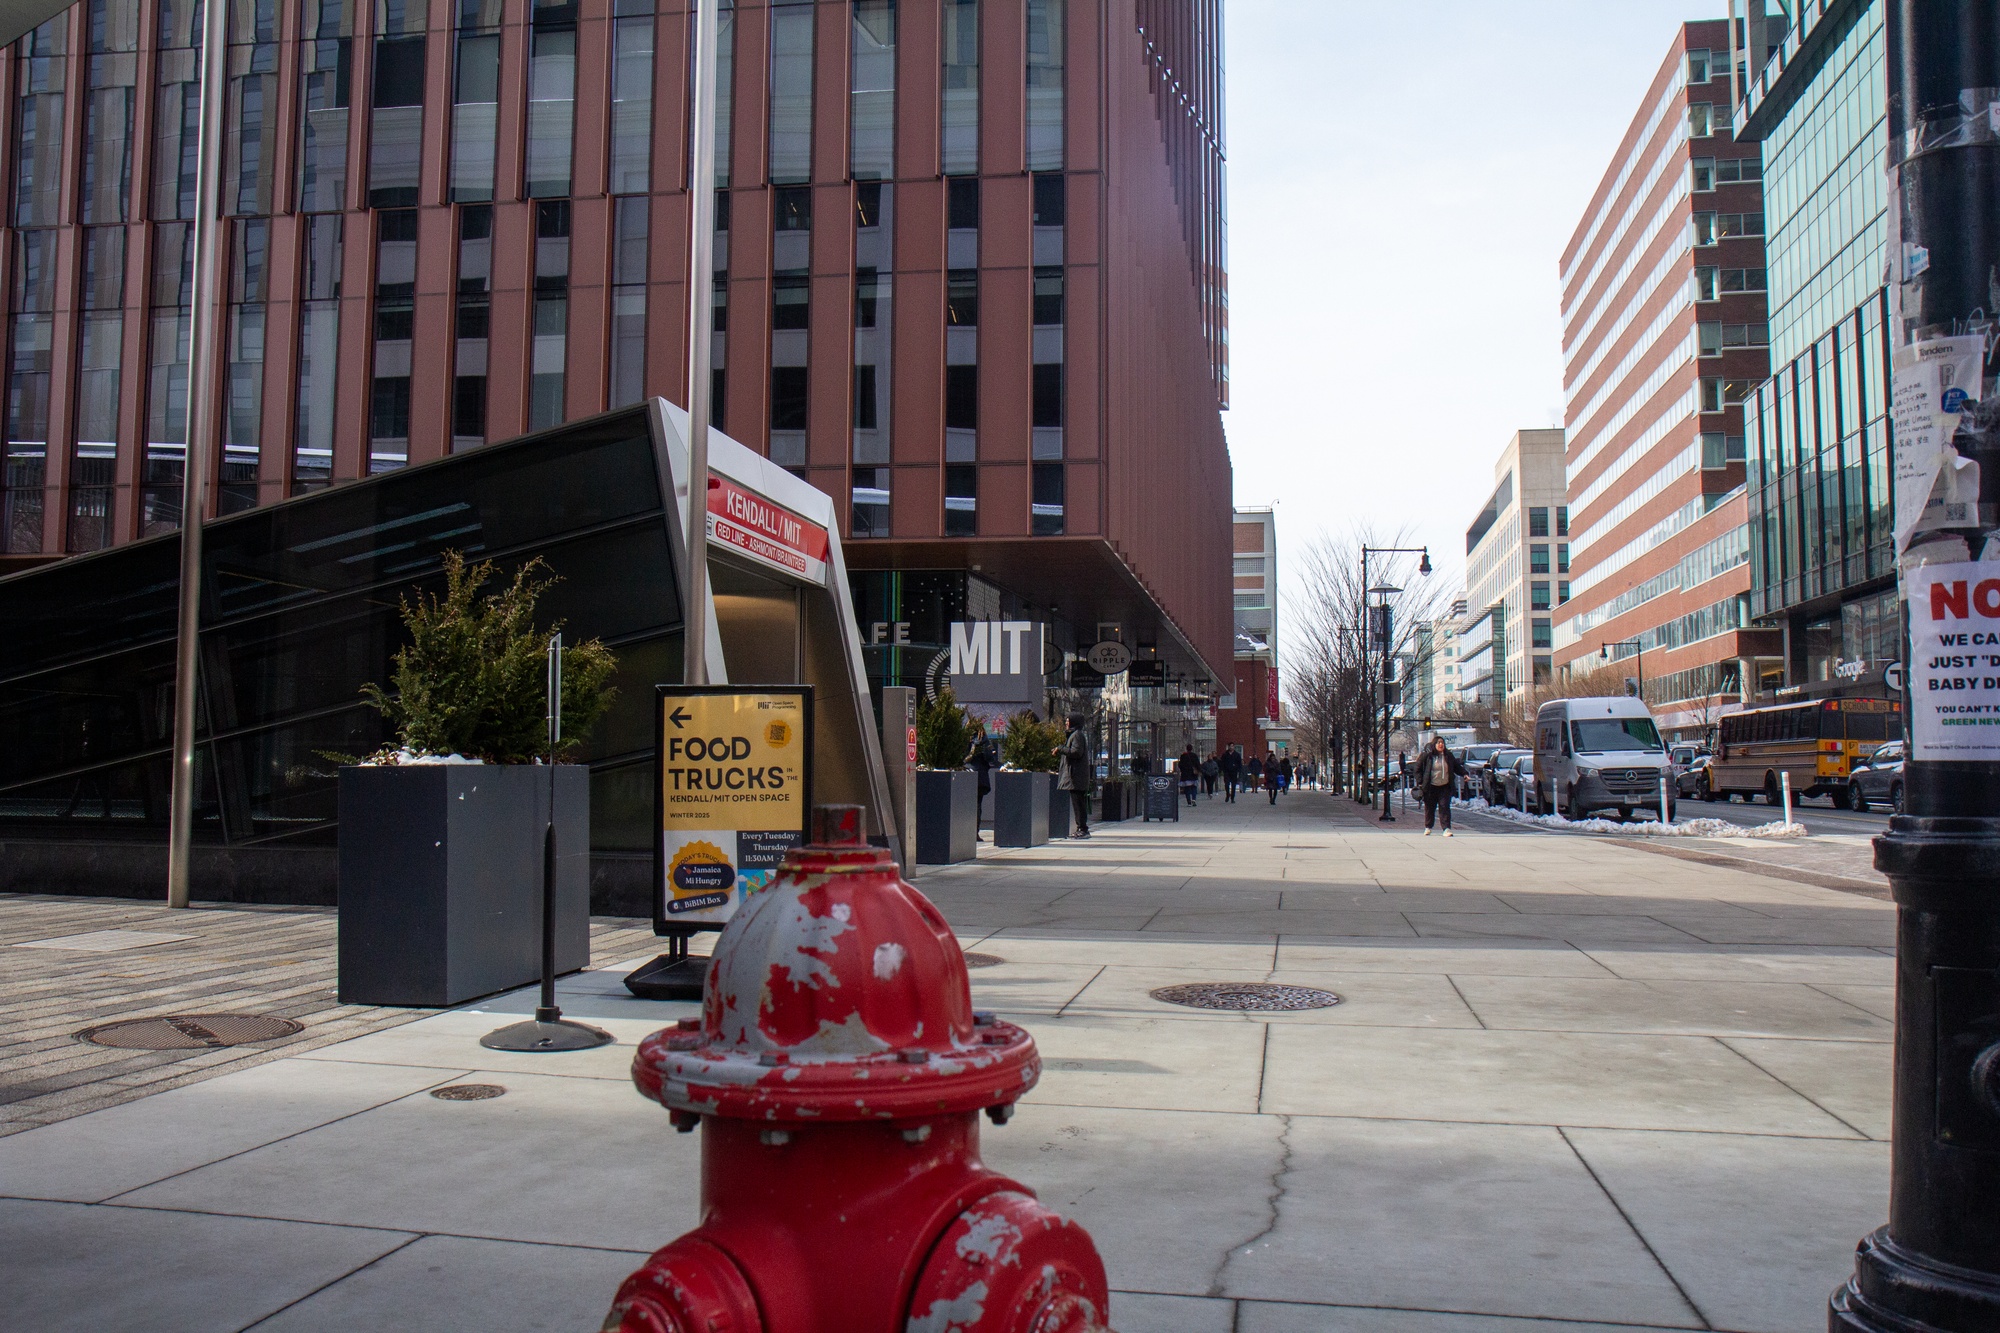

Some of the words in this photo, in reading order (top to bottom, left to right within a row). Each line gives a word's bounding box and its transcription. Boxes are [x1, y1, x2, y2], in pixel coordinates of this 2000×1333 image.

[1919, 345, 1953, 357] Tandem
[717, 523, 731, 538] RED
[731, 530, 745, 546] LINE
[748, 538, 805, 570] ASHMONT/BRAINTREE
[1939, 633, 1968, 646] WE
[1972, 632, 2000, 645] CA
[951, 622, 1031, 675] MIT
[1928, 655, 1977, 669] JUST
[1834, 655, 1866, 682] Google
[1928, 677, 1978, 691] BABY
[1983, 677, 2000, 689] D
[1843, 701, 1870, 711] SCHOOL
[1873, 701, 1887, 711] BUS
[1958, 705, 1991, 713] CAN'T
[1942, 718, 1977, 726] GREEN
[670, 736, 751, 762] FOOD
[668, 766, 784, 790] TRUCKS
[670, 794, 730, 803] KENDALL/MIT
[732, 794, 757, 802] OPEN
[759, 793, 790, 802] SPACE
[742, 832, 763, 841] Every
[764, 832, 796, 841] Tuesday
[753, 844, 789, 852] Thursday
[692, 866, 721, 874] Jamaica
[695, 877, 722, 886] Hungry
[707, 896, 721, 905] Box
